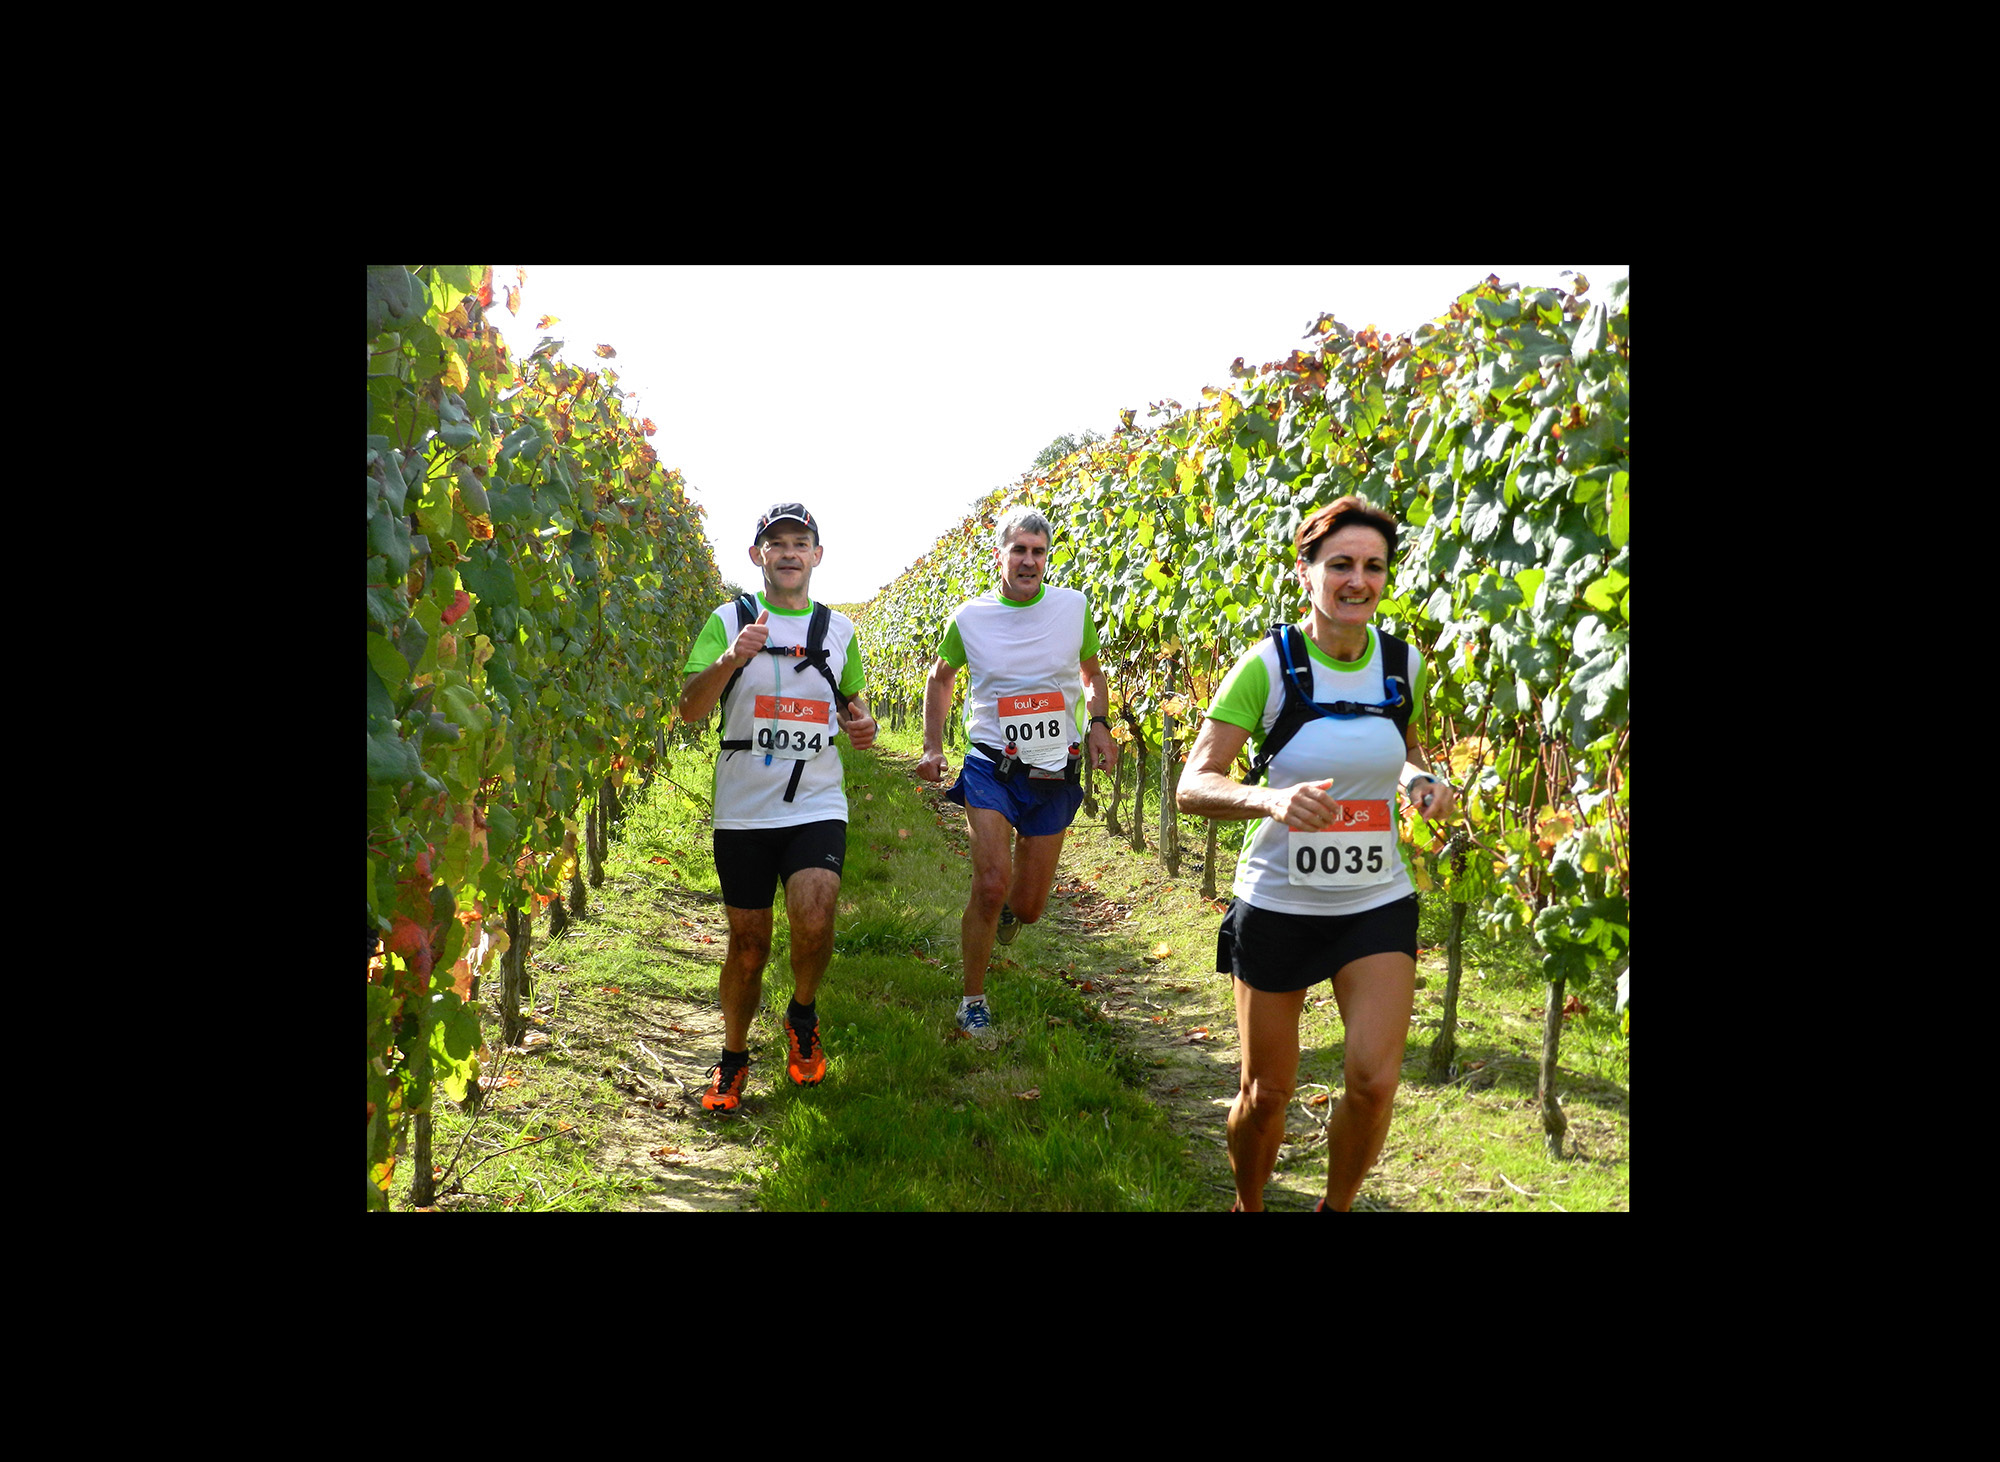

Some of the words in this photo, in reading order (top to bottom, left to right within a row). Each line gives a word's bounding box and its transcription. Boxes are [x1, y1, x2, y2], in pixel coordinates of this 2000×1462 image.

[757, 728, 822, 753] 0034
[1005, 719, 1060, 742] 0018
[1295, 845, 1383, 875] 0035
